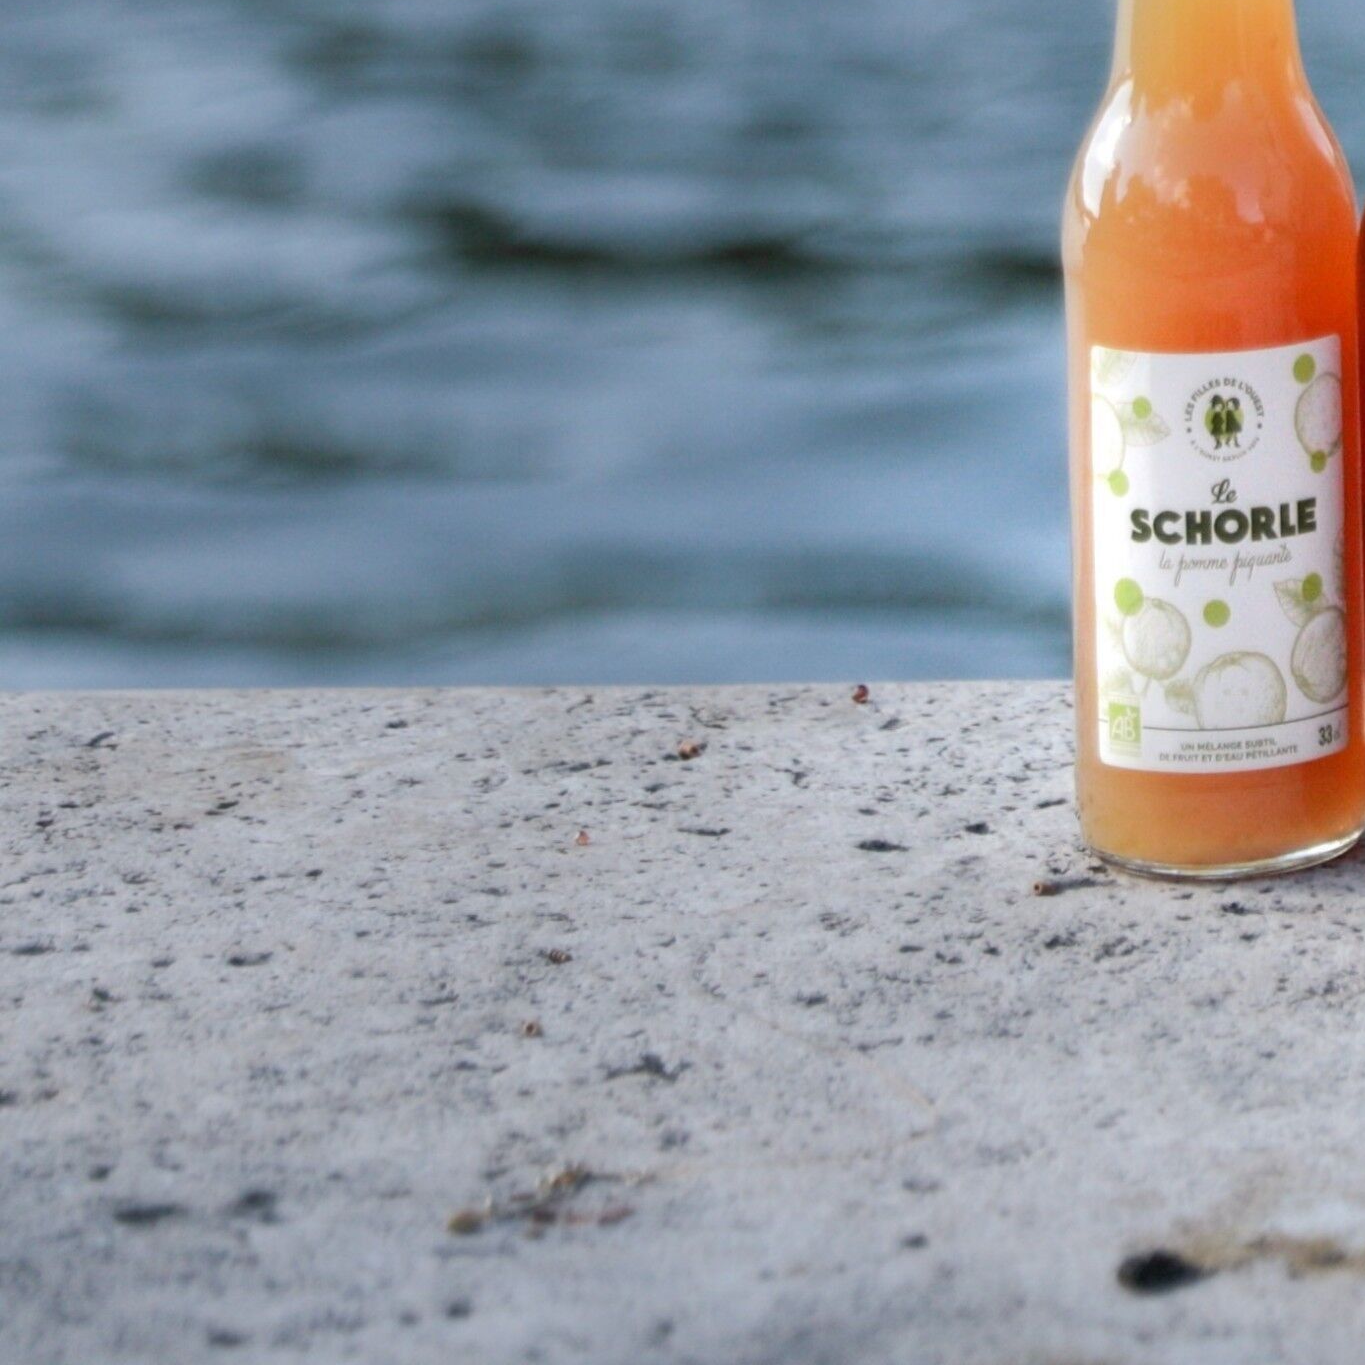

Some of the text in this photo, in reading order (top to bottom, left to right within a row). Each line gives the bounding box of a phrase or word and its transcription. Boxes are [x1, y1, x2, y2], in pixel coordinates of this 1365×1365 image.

[1210, 478, 1237, 505] Le
[1130, 497, 1317, 545] SCHORLE
[1158, 544, 1292, 586] la pomme piquante
[1318, 725, 1333, 746] 33
